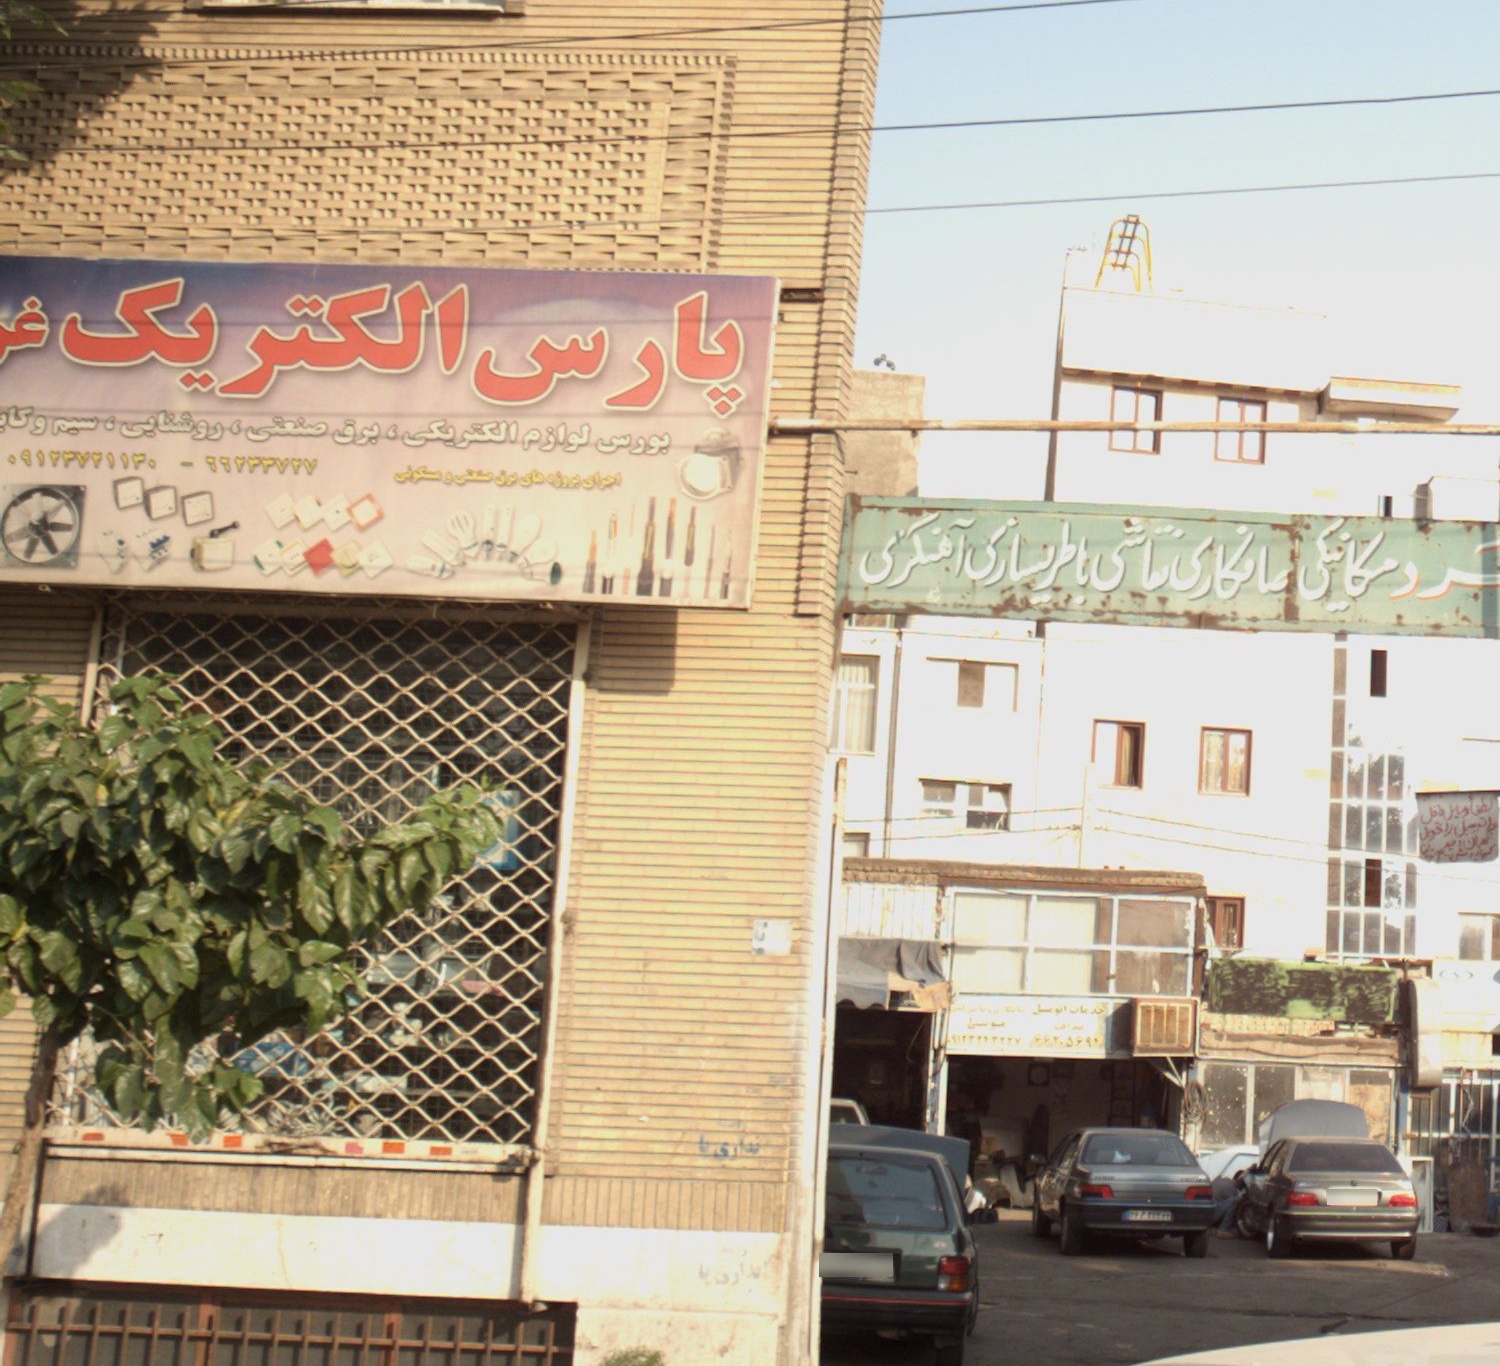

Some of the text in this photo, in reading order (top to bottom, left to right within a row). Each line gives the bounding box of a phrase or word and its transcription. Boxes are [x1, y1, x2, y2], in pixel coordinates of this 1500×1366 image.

[59, 277, 468, 398] الکتریک
[472, 290, 746, 418] پارس
[53, 413, 98, 433] سیم
[120, 404, 222, 440] روشنایی
[247, 417, 328, 442] صنعتی
[333, 421, 381, 445] برق
[402, 420, 518, 450] الکتریکی
[522, 423, 591, 452] لوازم
[596, 431, 671, 455] بورس
[495, 469, 518, 486] برق
[585, 471, 622, 489] اجرای
